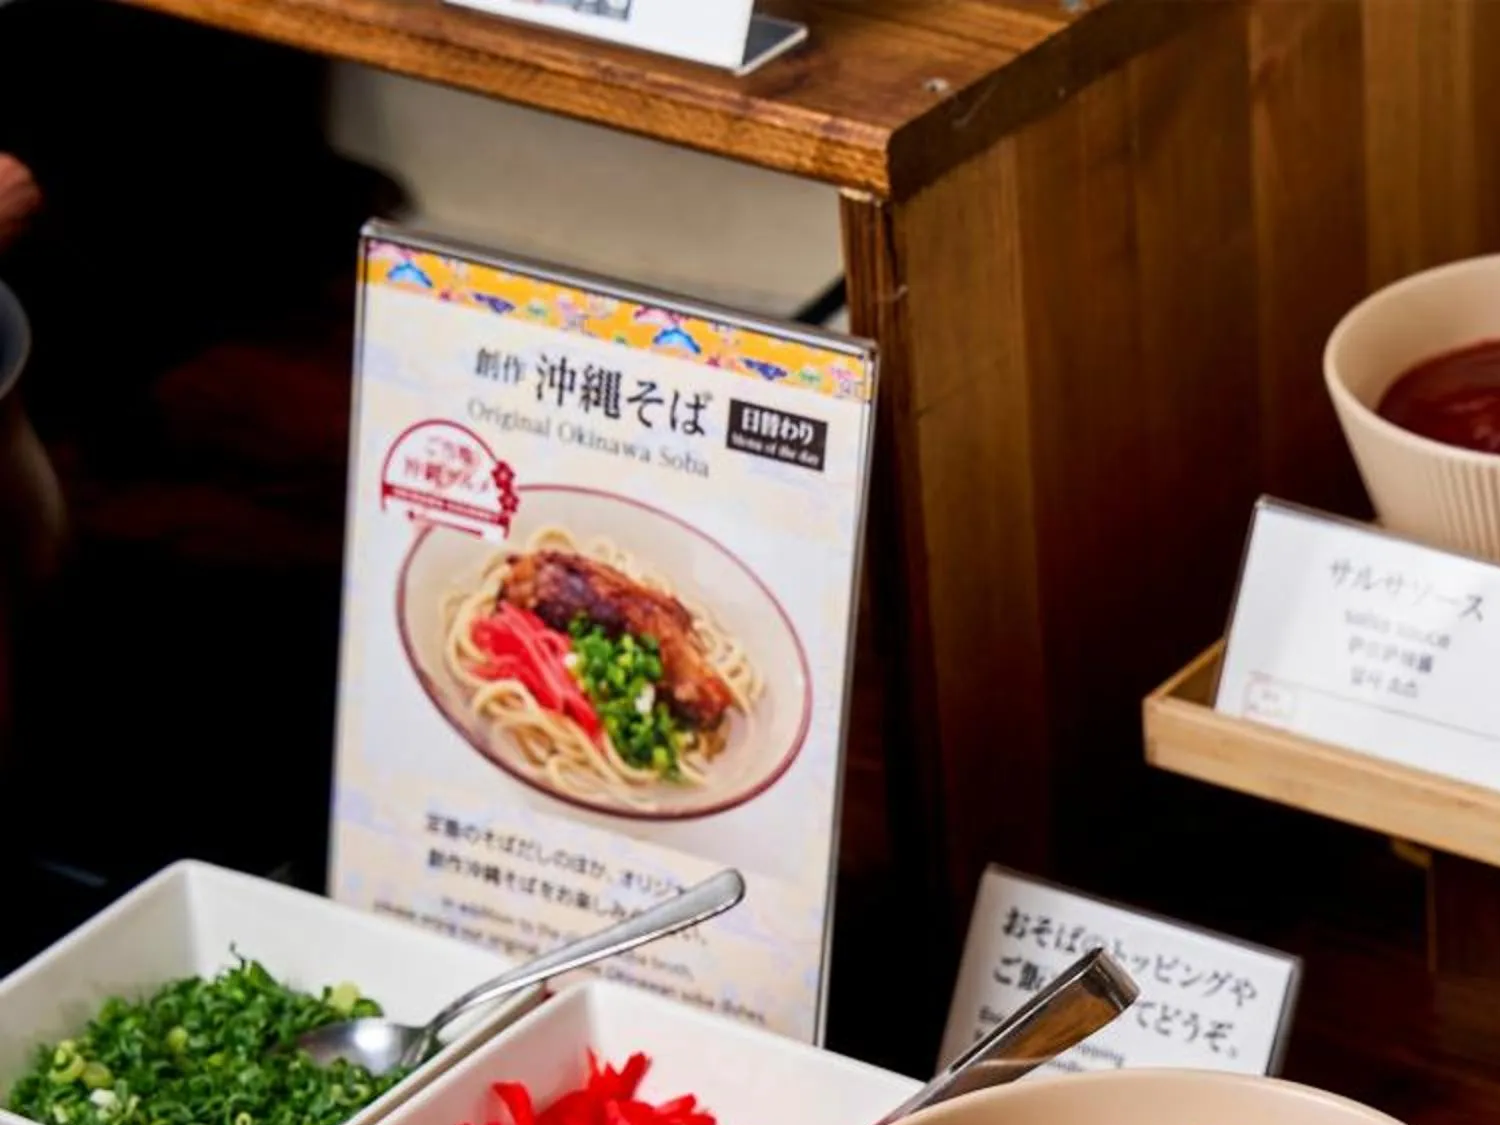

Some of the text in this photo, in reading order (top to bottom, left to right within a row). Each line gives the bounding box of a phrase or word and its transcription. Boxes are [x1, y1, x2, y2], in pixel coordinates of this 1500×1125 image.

[475, 346, 712, 436] 創作 沖縄そば
[467, 398, 710, 478] Original Okinawa Soba
